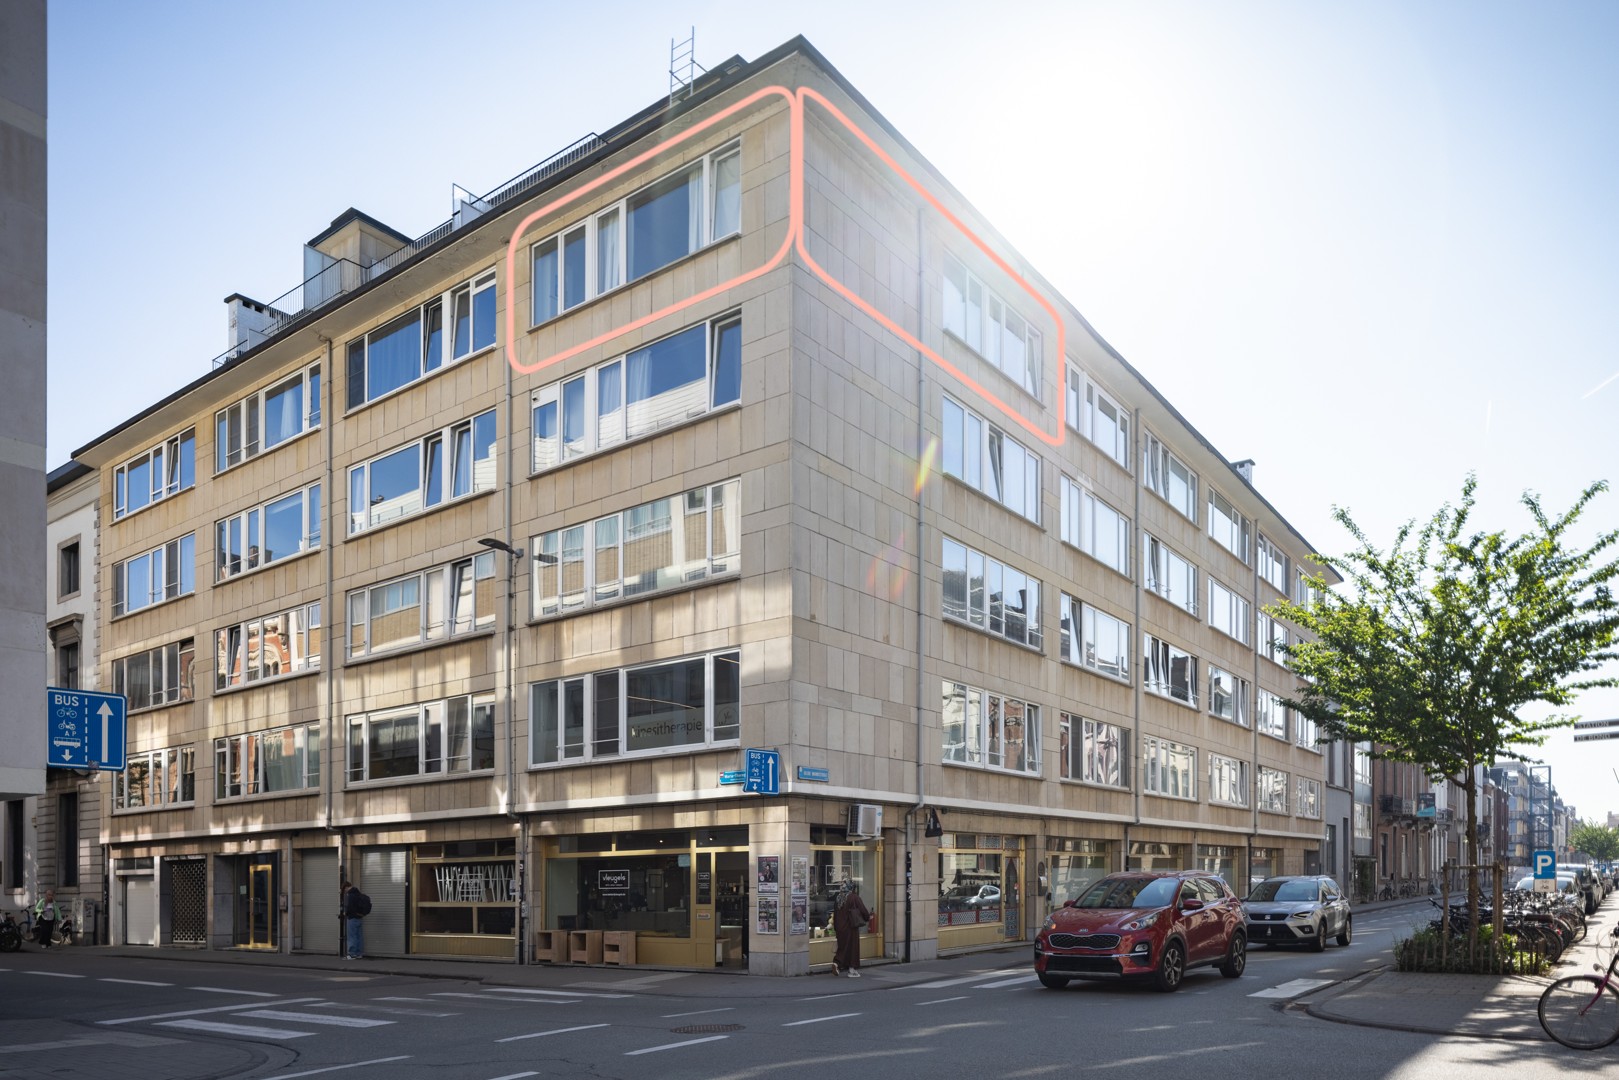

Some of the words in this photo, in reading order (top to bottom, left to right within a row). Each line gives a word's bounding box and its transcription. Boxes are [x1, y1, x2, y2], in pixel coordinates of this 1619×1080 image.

[54, 694, 79, 707] BUS
[631, 719, 702, 738] kinesitherapie
[1536, 854, 1553, 875] P
[602, 873, 626, 884] vleugels
